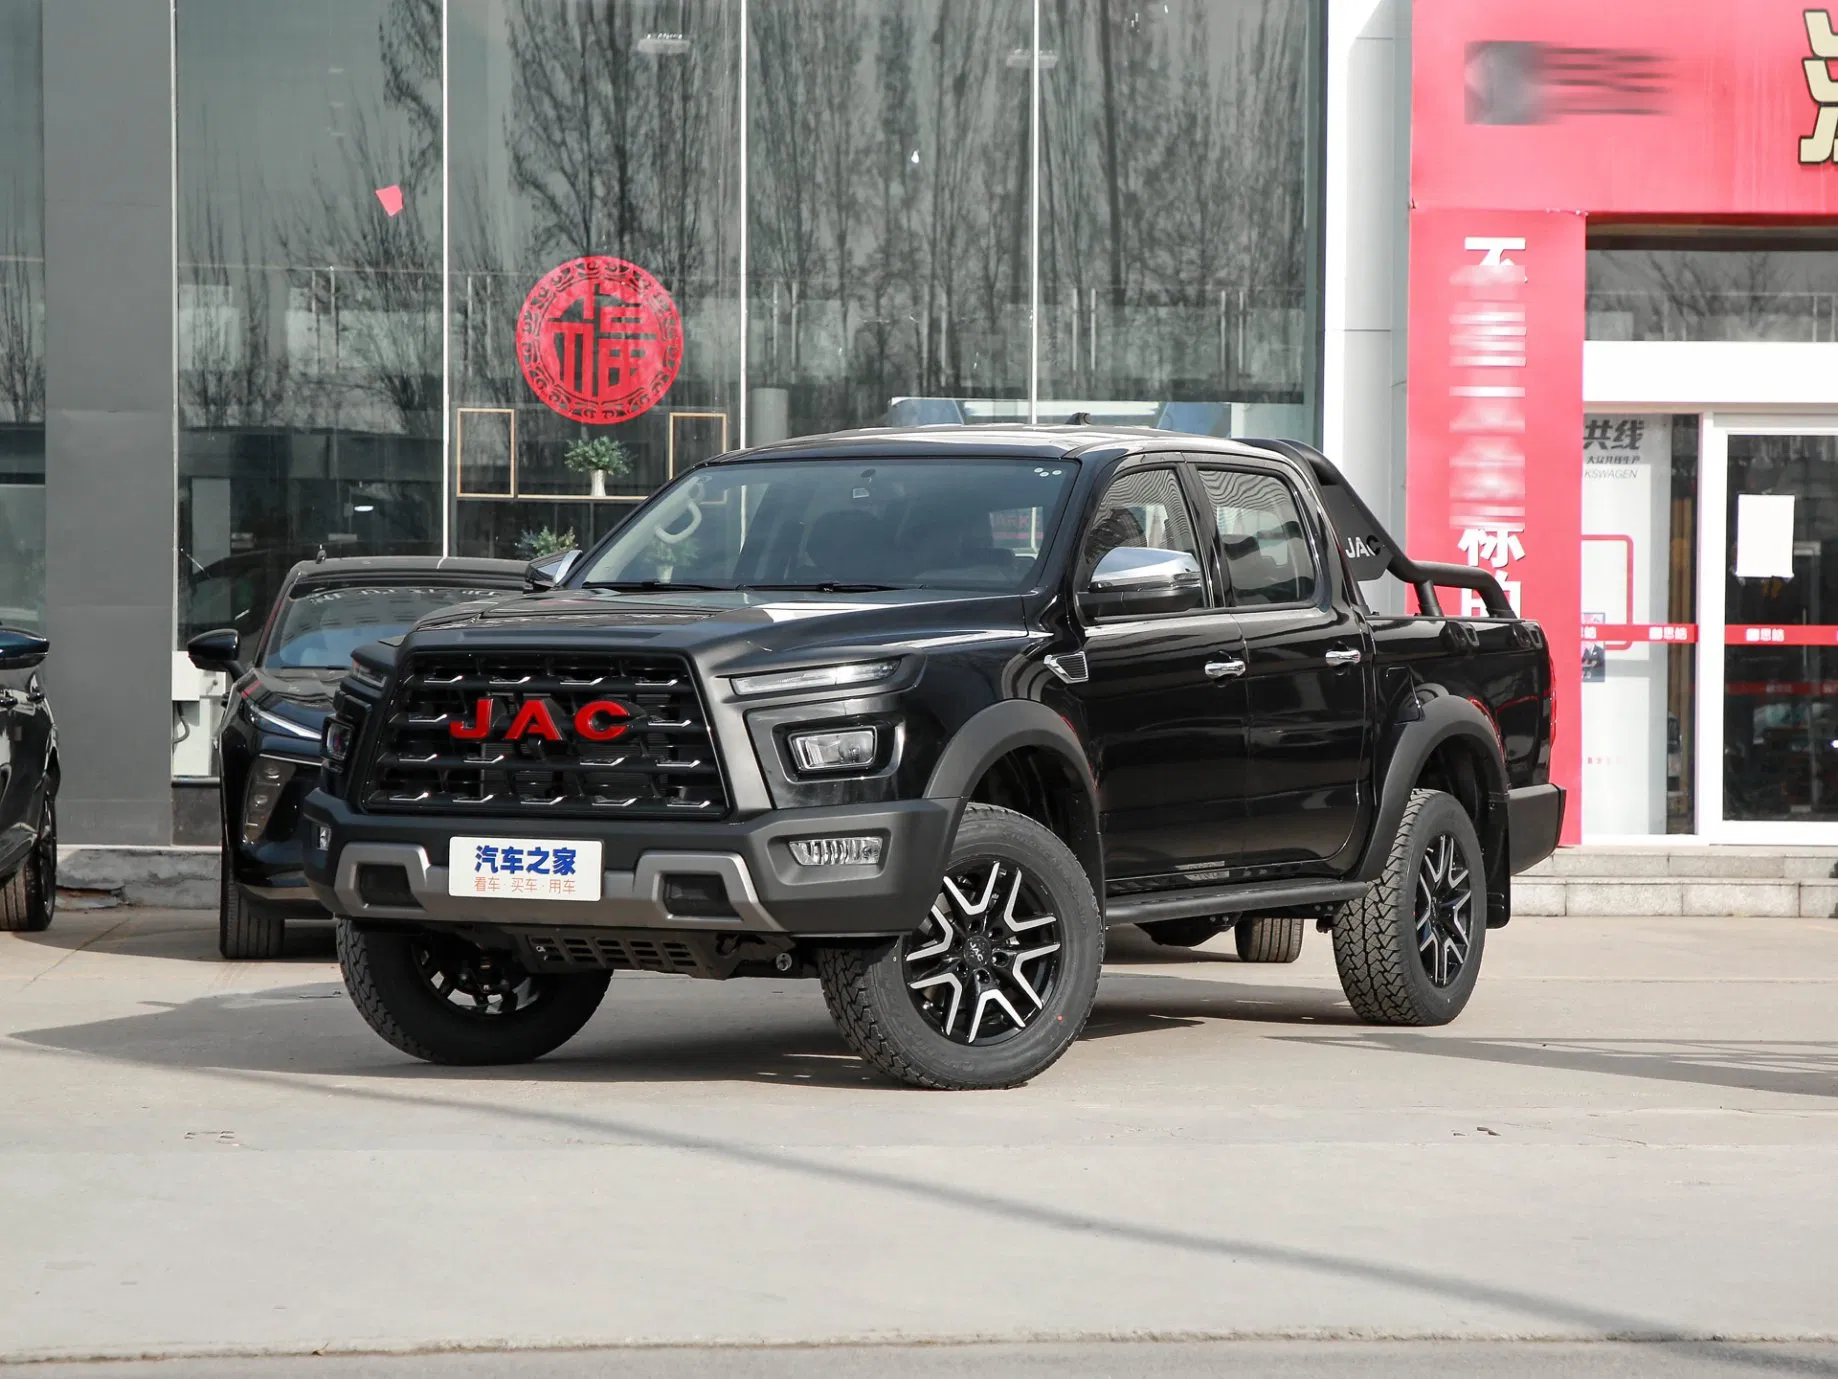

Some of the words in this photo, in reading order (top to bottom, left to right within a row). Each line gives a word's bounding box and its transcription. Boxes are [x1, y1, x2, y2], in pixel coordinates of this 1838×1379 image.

[1583, 419, 1644, 450] 共线
[1345, 534, 1381, 558] JAC
[449, 699, 630, 741] JAC
[474, 845, 577, 876] 汽车之家
[969, 941, 984, 962] JAC
